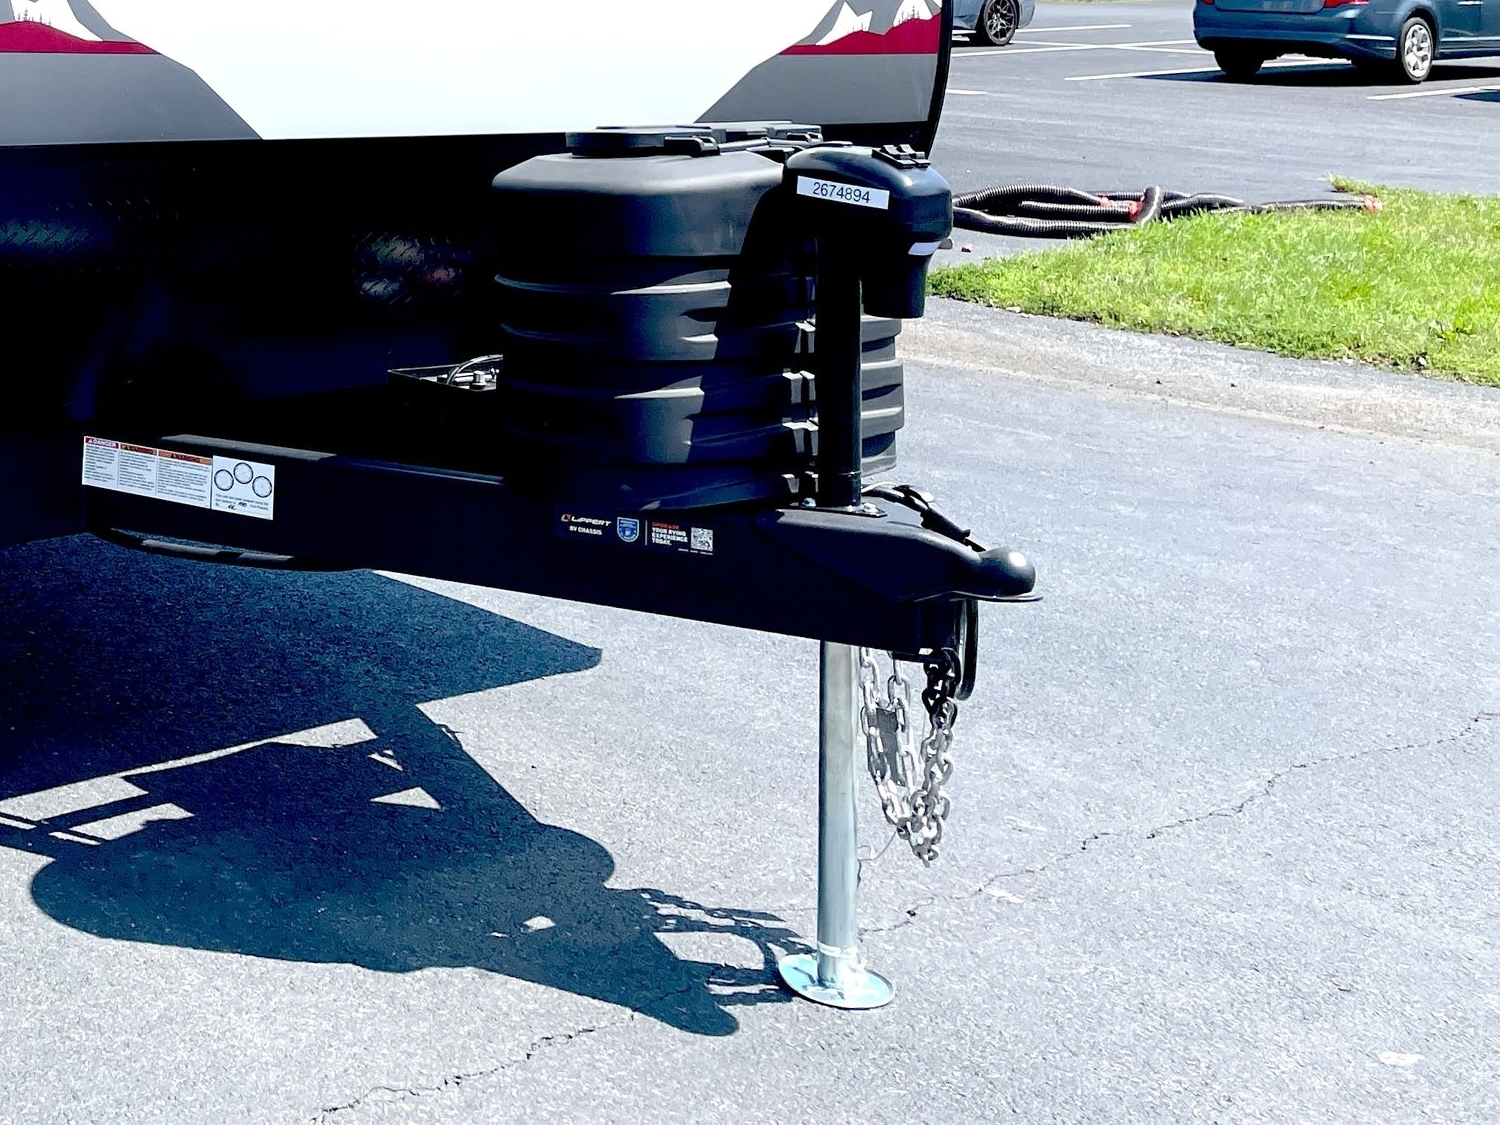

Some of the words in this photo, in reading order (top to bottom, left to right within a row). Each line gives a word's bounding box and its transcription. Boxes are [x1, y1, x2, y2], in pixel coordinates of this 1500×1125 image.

[812, 181, 870, 204] 2674894
[571, 515, 612, 527] LIPPERT
[578, 526, 602, 536] CHASSIS
[652, 532, 688, 543] EXPERIENCE
